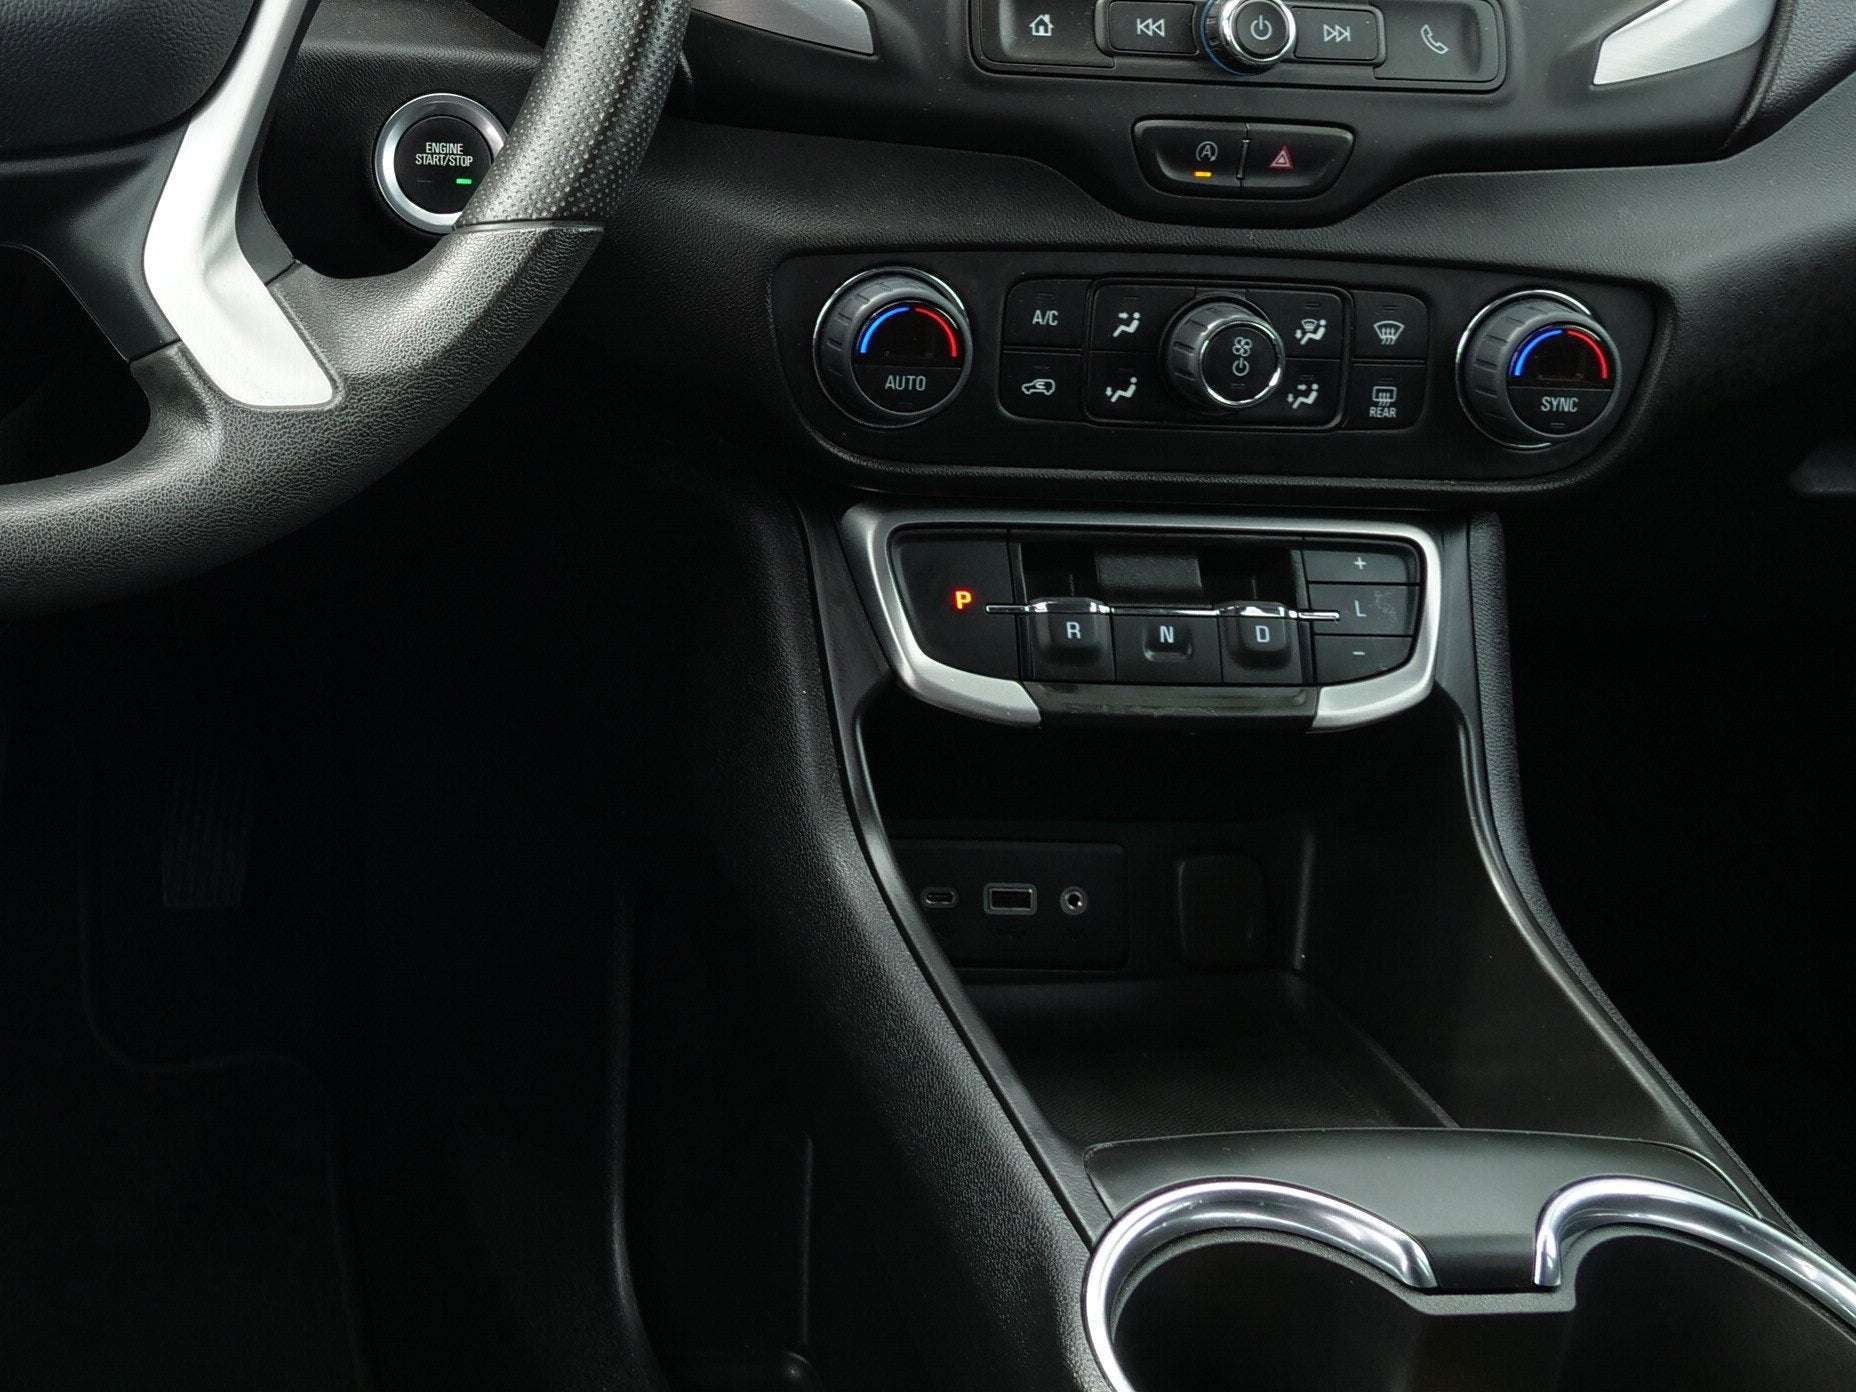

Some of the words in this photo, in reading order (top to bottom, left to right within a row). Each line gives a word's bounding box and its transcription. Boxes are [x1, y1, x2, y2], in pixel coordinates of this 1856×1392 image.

[425, 141, 464, 155] ENGINE
[415, 153, 474, 167] START/STOP
[1031, 309, 1059, 326] A/C
[884, 374, 927, 391] AUTO
[1369, 407, 1397, 419] REAR
[1540, 396, 1579, 414] SYNC
[955, 590, 972, 610] P
[1355, 600, 1366, 618] L
[1066, 621, 1081, 641] R
[1159, 626, 1174, 644] N
[1256, 625, 1270, 644] D
